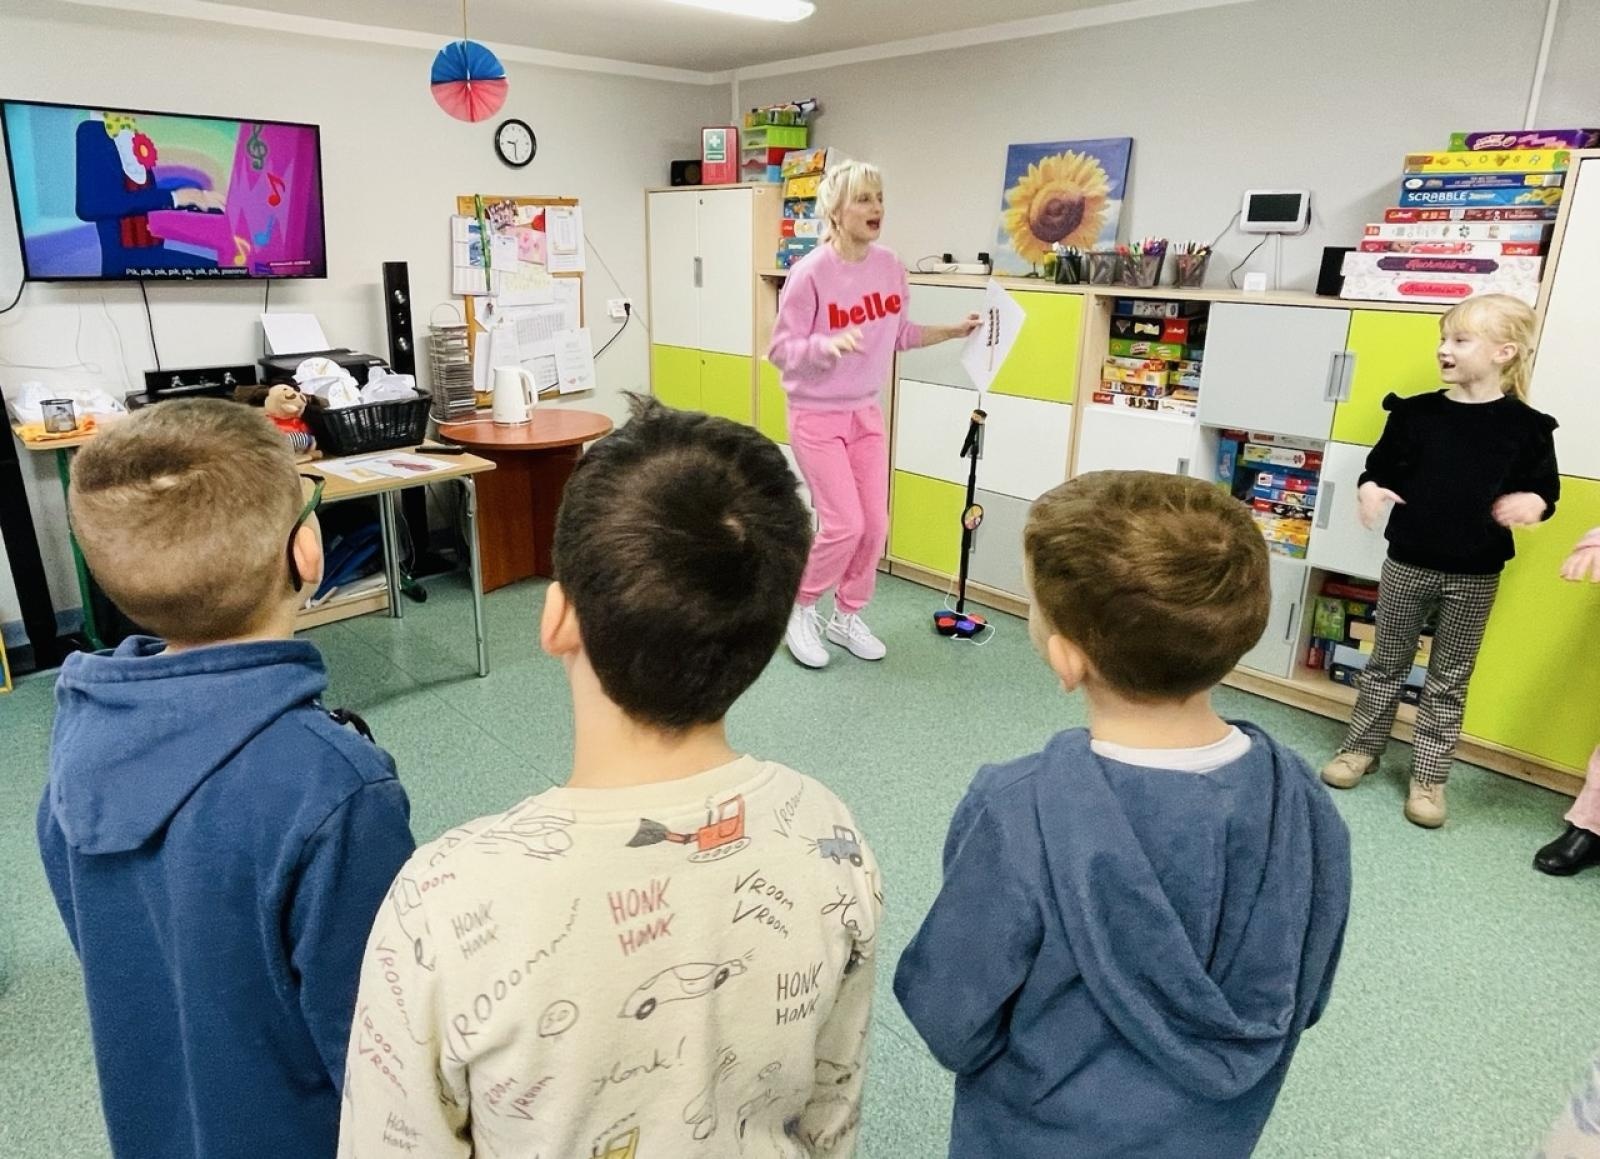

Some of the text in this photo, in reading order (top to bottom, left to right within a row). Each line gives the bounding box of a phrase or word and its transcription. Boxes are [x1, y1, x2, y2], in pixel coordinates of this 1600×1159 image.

[1408, 191, 1467, 203] SCRABBLE
[829, 292, 900, 330] belle
[608, 877, 671, 924] HONK
[735, 869, 794, 911] VROOM
[619, 913, 675, 956] HONK
[732, 900, 788, 939] VROOM
[777, 962, 824, 1000] HONK
[776, 994, 820, 1025] HONK
